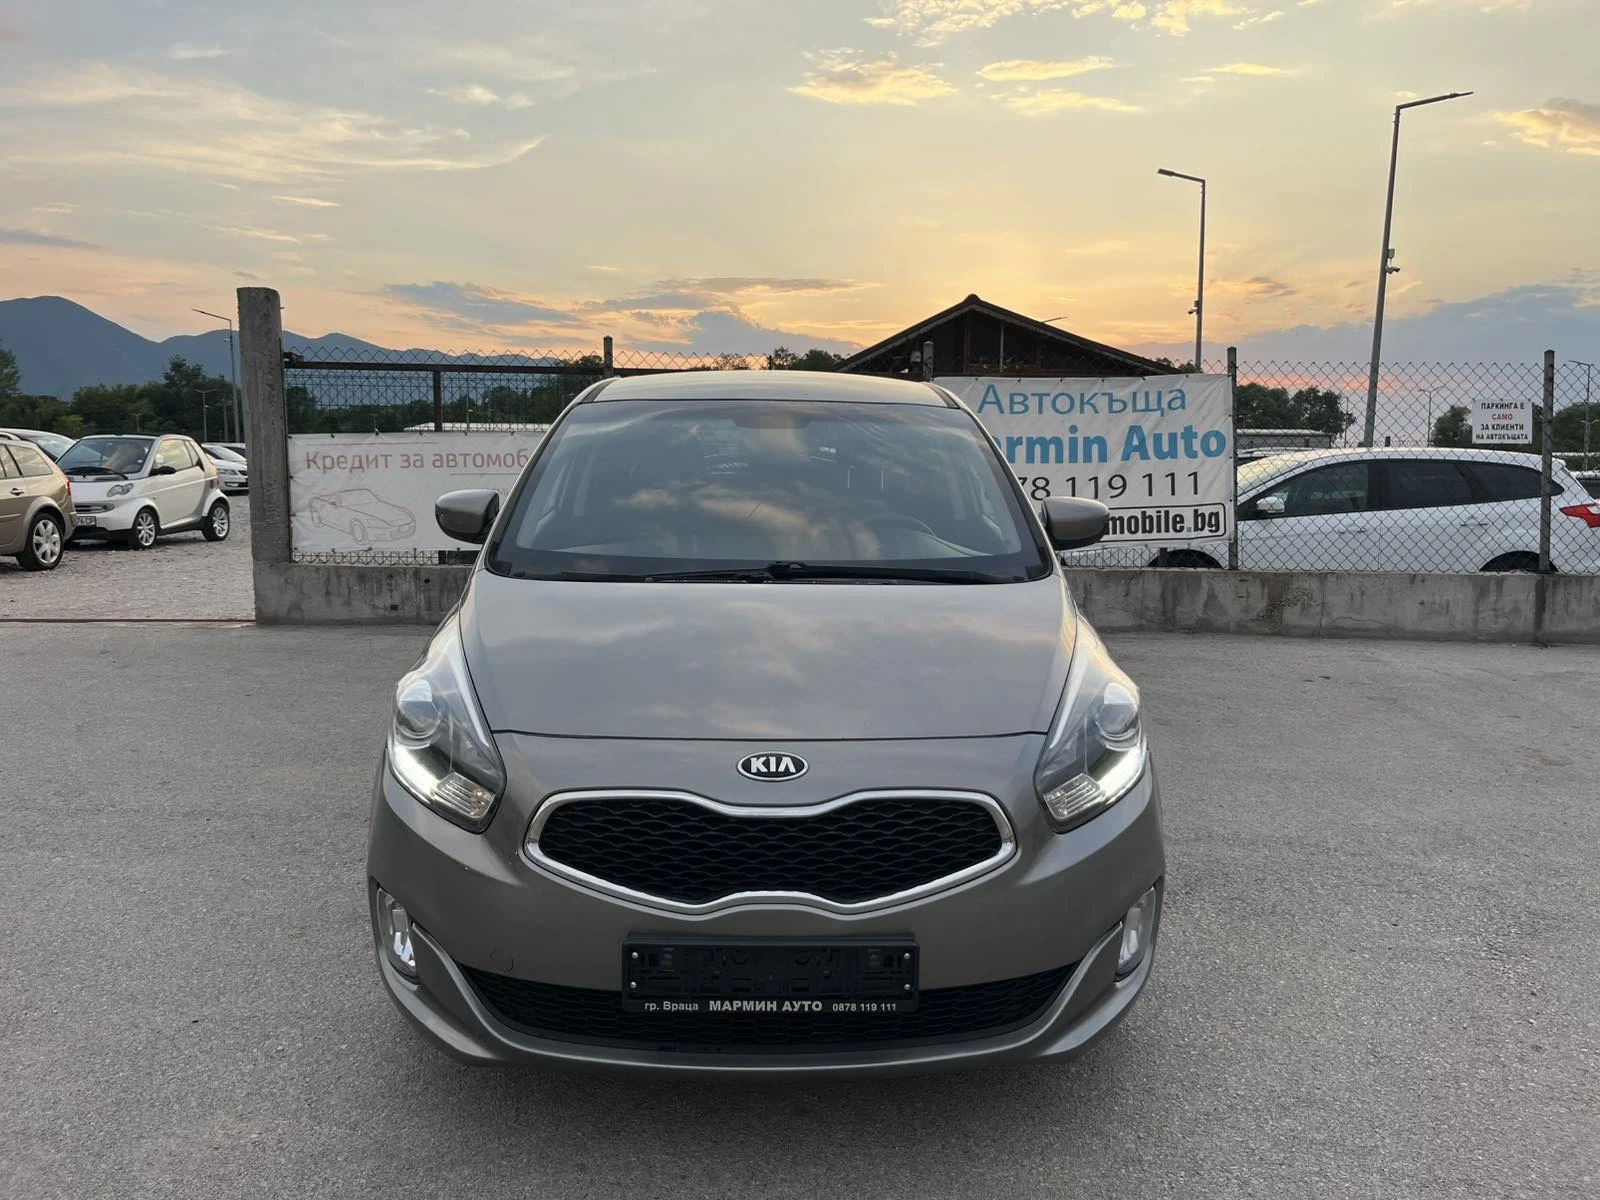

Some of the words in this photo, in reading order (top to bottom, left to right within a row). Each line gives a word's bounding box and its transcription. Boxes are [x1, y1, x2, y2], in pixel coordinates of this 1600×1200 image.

[977, 383, 1186, 416] Автокъща
[992, 425, 1107, 464] rmin
[1121, 425, 1226, 461] Auto
[306, 451, 393, 473] Кредит
[400, 454, 424, 469] за
[1066, 474, 1128, 499] 119
[1142, 471, 1199, 496] 111
[750, 756, 796, 773] KIA
[644, 1002, 660, 1012] гр.
[663, 1001, 699, 1012] Враца
[709, 1000, 777, 1012] МАРМИН
[782, 1000, 823, 1012] АУТО
[832, 1002, 857, 1012] 0878
[860, 1002, 877, 1011] 119
[880, 1002, 896, 1011] 111
